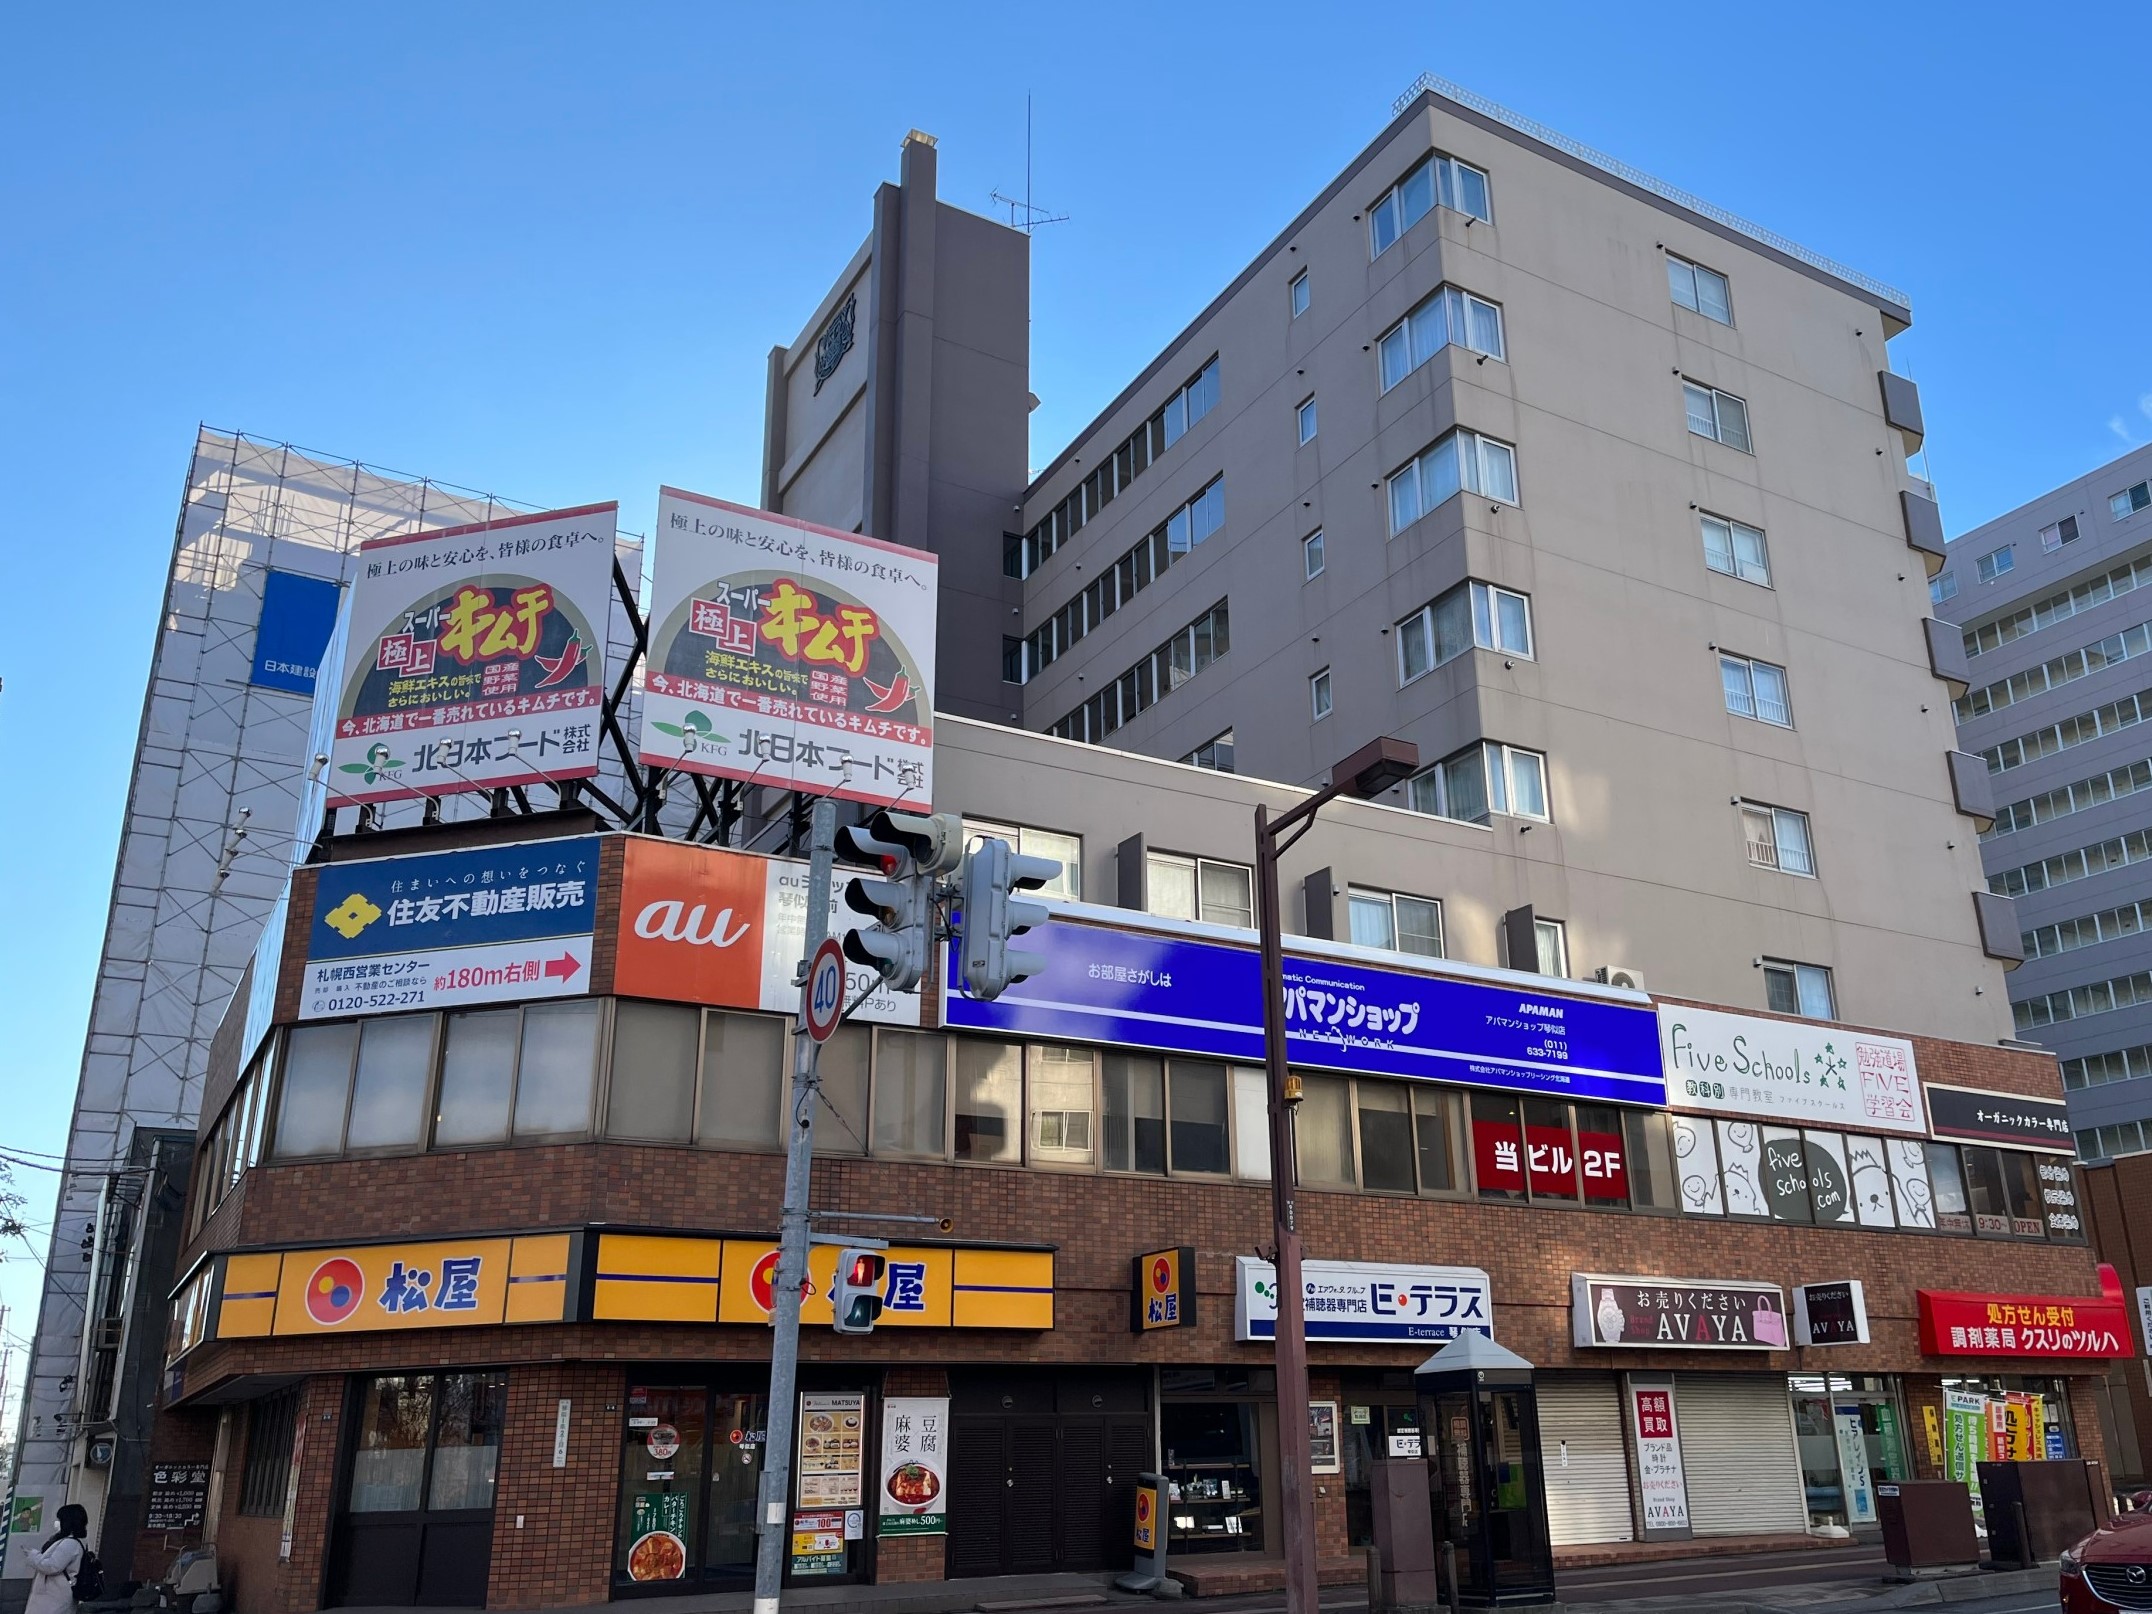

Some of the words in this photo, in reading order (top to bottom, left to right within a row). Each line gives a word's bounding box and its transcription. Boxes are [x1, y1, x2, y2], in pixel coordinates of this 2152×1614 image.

[367, 531, 605, 579] 極上の味と安心を、皆様の食卓へ。
[670, 512, 929, 592] 極上の味と安心を、皆様の食卓へ。
[439, 586, 551, 660] キムチ
[694, 604, 752, 651] 極上
[758, 582, 879, 673] キムチ
[382, 635, 432, 674] 極上
[705, 650, 809, 684] 海鮮エキスの旨味で
[388, 673, 482, 695] 海鮮エキスの旨味で
[705, 667, 798, 696] さらにおいしい。
[388, 690, 471, 708] さらにおいしい。
[652, 675, 927, 745] 今、北海道で一番売れているキムチです。
[342, 689, 596, 736] 今、北海道で一番売れているキムチです。
[701, 742, 728, 756] KFG
[391, 860, 586, 893] 住まいへの想いをつなぐ
[387, 880, 586, 927] 住友不動産販売
[634, 899, 751, 948] au
[317, 960, 430, 983] 札幌西営業センター
[433, 959, 541, 991] 約180m右側
[1088, 963, 1172, 988] お部屋さがしは
[1305, 975, 1366, 992] Communication
[328, 990, 425, 1011] 0120-522-271
[814, 965, 837, 1014] 40
[1519, 1003, 1564, 1019] APAMAN
[1526, 1046, 1569, 1060] 633-7199
[1544, 1039, 1568, 1051] (011)
[1672, 1023, 1728, 1072] Five
[1733, 1035, 1811, 1084] Schools
[1685, 1079, 1725, 1100] 教科別
[1860, 1071, 1910, 1094] FIVE
[1865, 1094, 1913, 1119] 学習会
[1976, 1109, 2070, 1134] オーガニックカラー専門店
[1767, 1146, 1803, 1172] five
[1816, 1190, 1842, 1211] .com
[2013, 1219, 2041, 1234] OPEN
[376, 1255, 483, 1315] 松屋
[1148, 1292, 1178, 1324] 松屋
[1301, 1297, 1368, 1313] 補聴器専門店
[1637, 1290, 1746, 1310] お売りください
[1812, 1319, 1855, 1334] AVAYA
[1987, 1303, 2075, 1327] 処方せん受付
[1408, 1326, 1445, 1337] E-terrace
[1656, 1312, 1748, 1343] AVAYA
[1950, 1326, 2017, 1350] 調剤薬局
[2020, 1328, 2120, 1352] クスリのツルハ
[831, 1399, 861, 1407] MATSUYA
[1641, 1396, 1666, 1413] 高額
[1643, 1416, 1668, 1433] 買取
[153, 1470, 206, 1484] 色彩堂
[817, 1518, 832, 1528] 100
[1648, 1505, 1685, 1518] AVAYA
